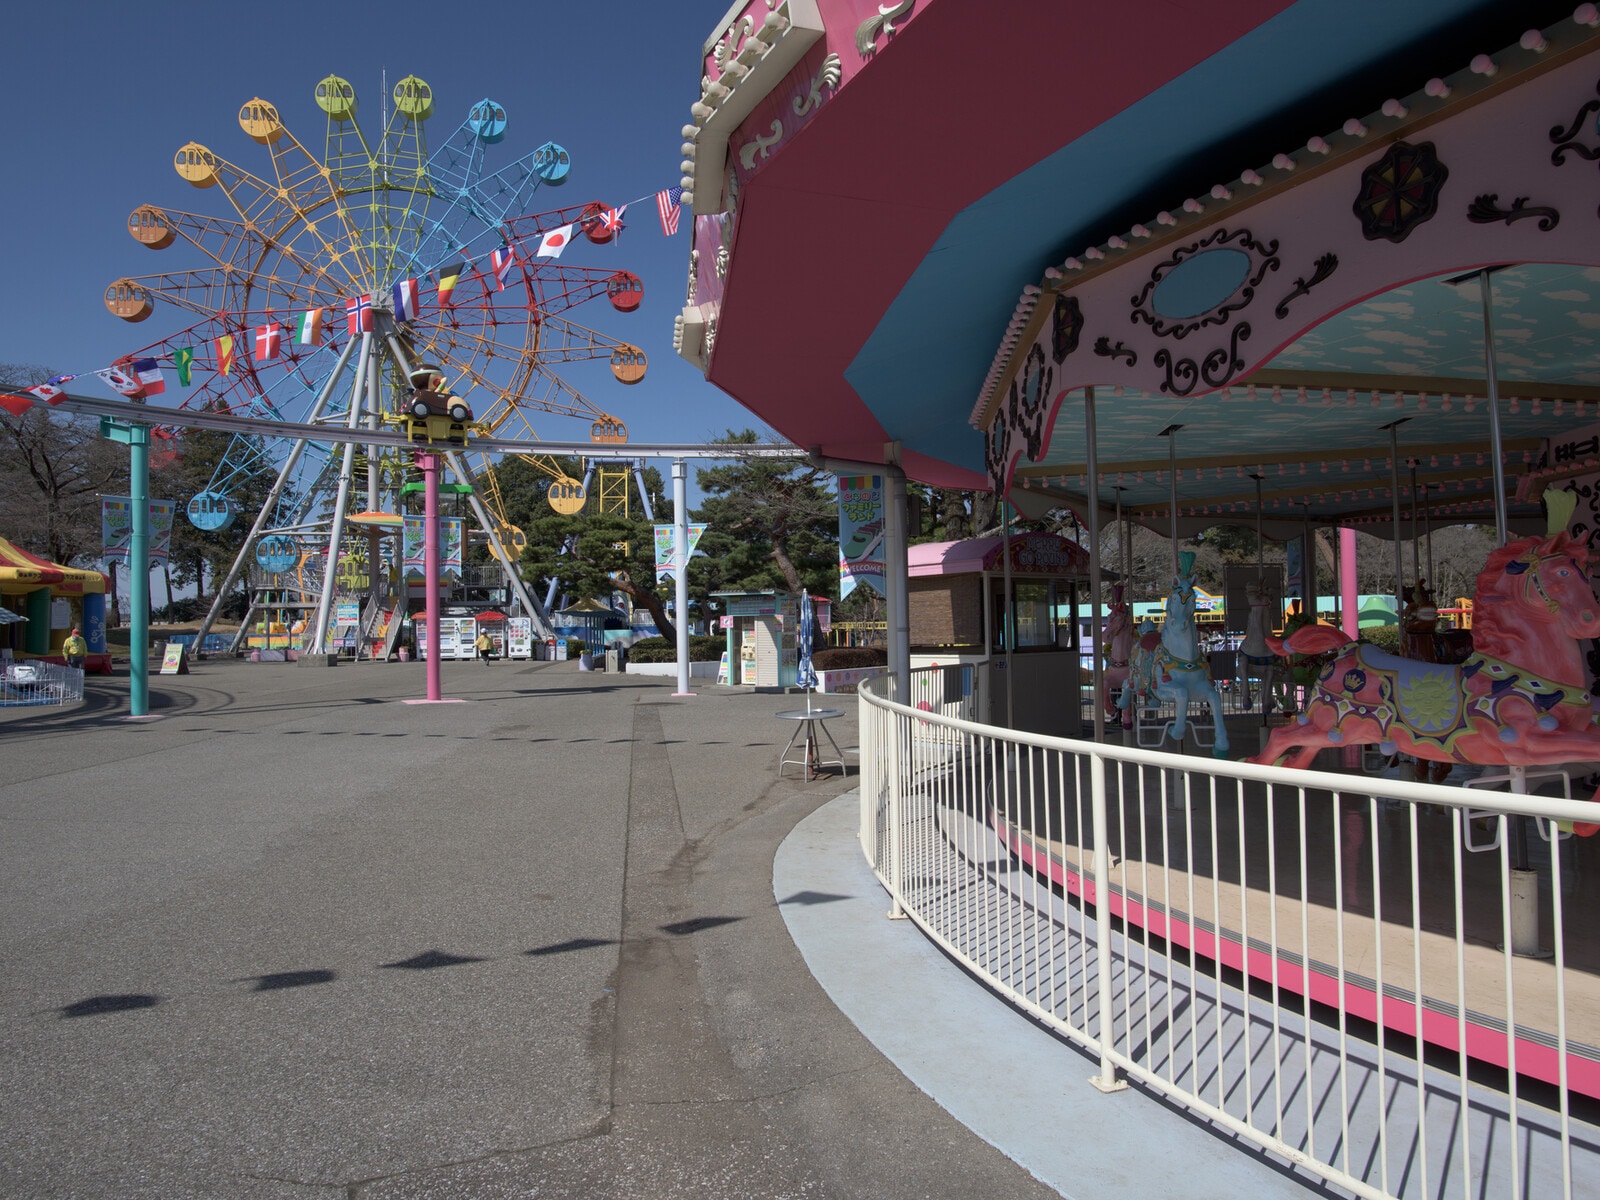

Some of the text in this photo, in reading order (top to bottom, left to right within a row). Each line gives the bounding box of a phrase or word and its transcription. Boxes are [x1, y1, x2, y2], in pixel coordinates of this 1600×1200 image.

[841, 502, 881, 512] ファミリー
[848, 512, 875, 522] ランド
[844, 563, 881, 573] WELCOME
